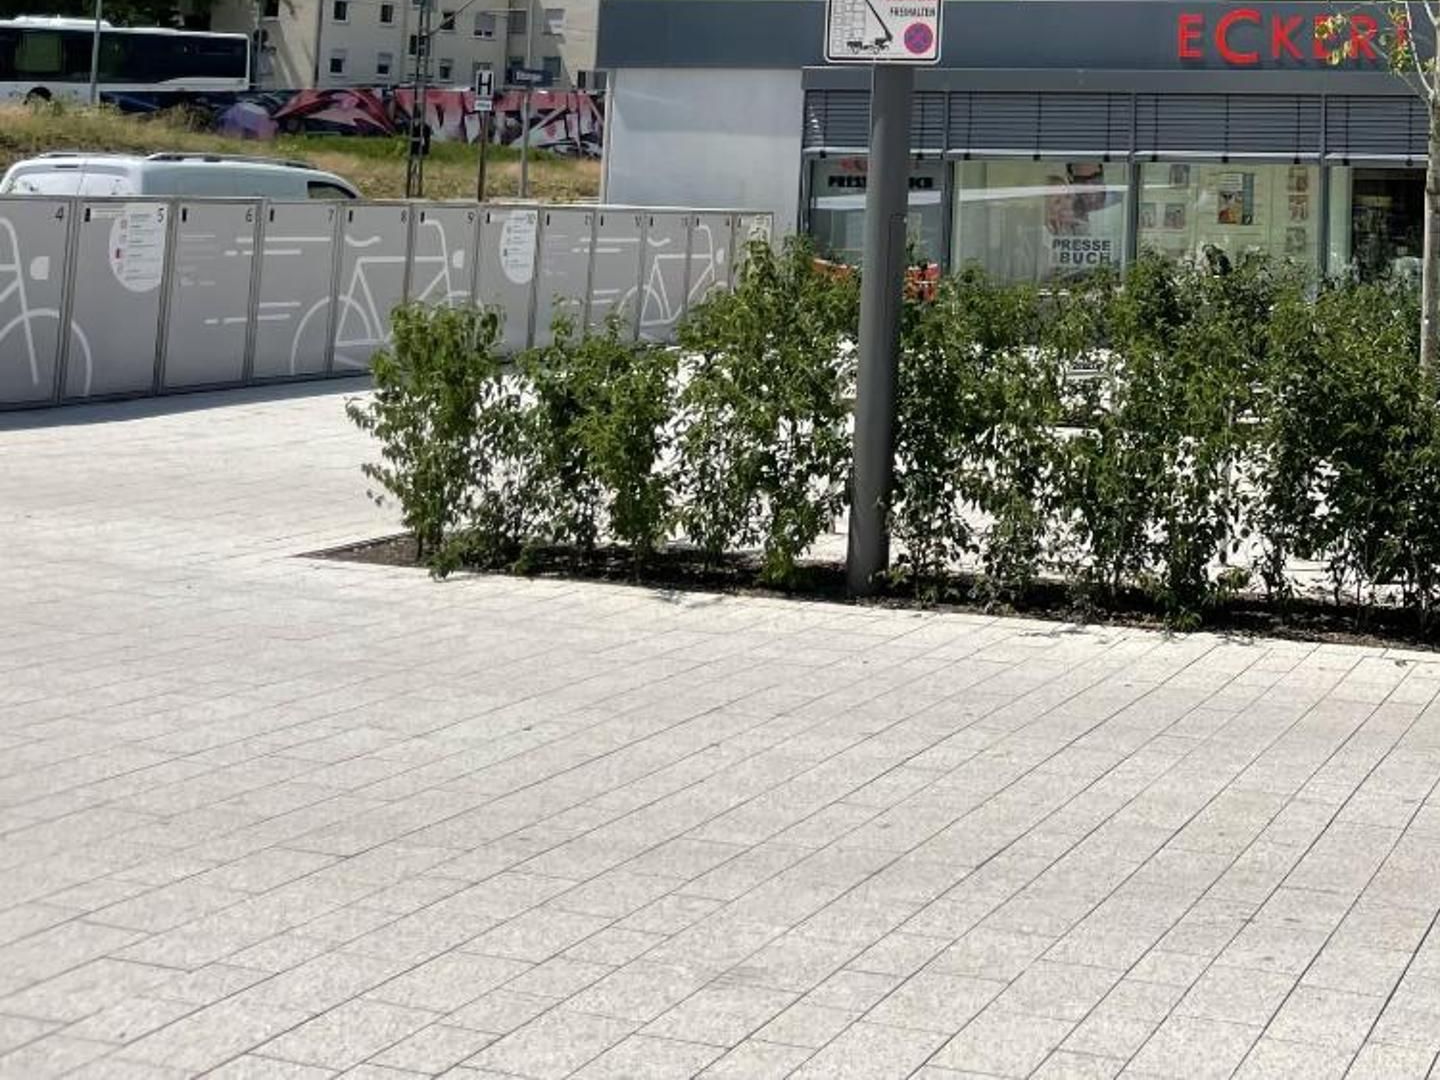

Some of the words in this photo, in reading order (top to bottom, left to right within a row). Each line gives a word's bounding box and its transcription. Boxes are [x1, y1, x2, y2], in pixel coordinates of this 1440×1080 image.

[478, 72, 492, 96] H
[55, 206, 64, 221] 4
[157, 207, 164, 222] 5
[1052, 239, 1112, 251] PRESSE
[1060, 252, 1112, 265] BUCH
